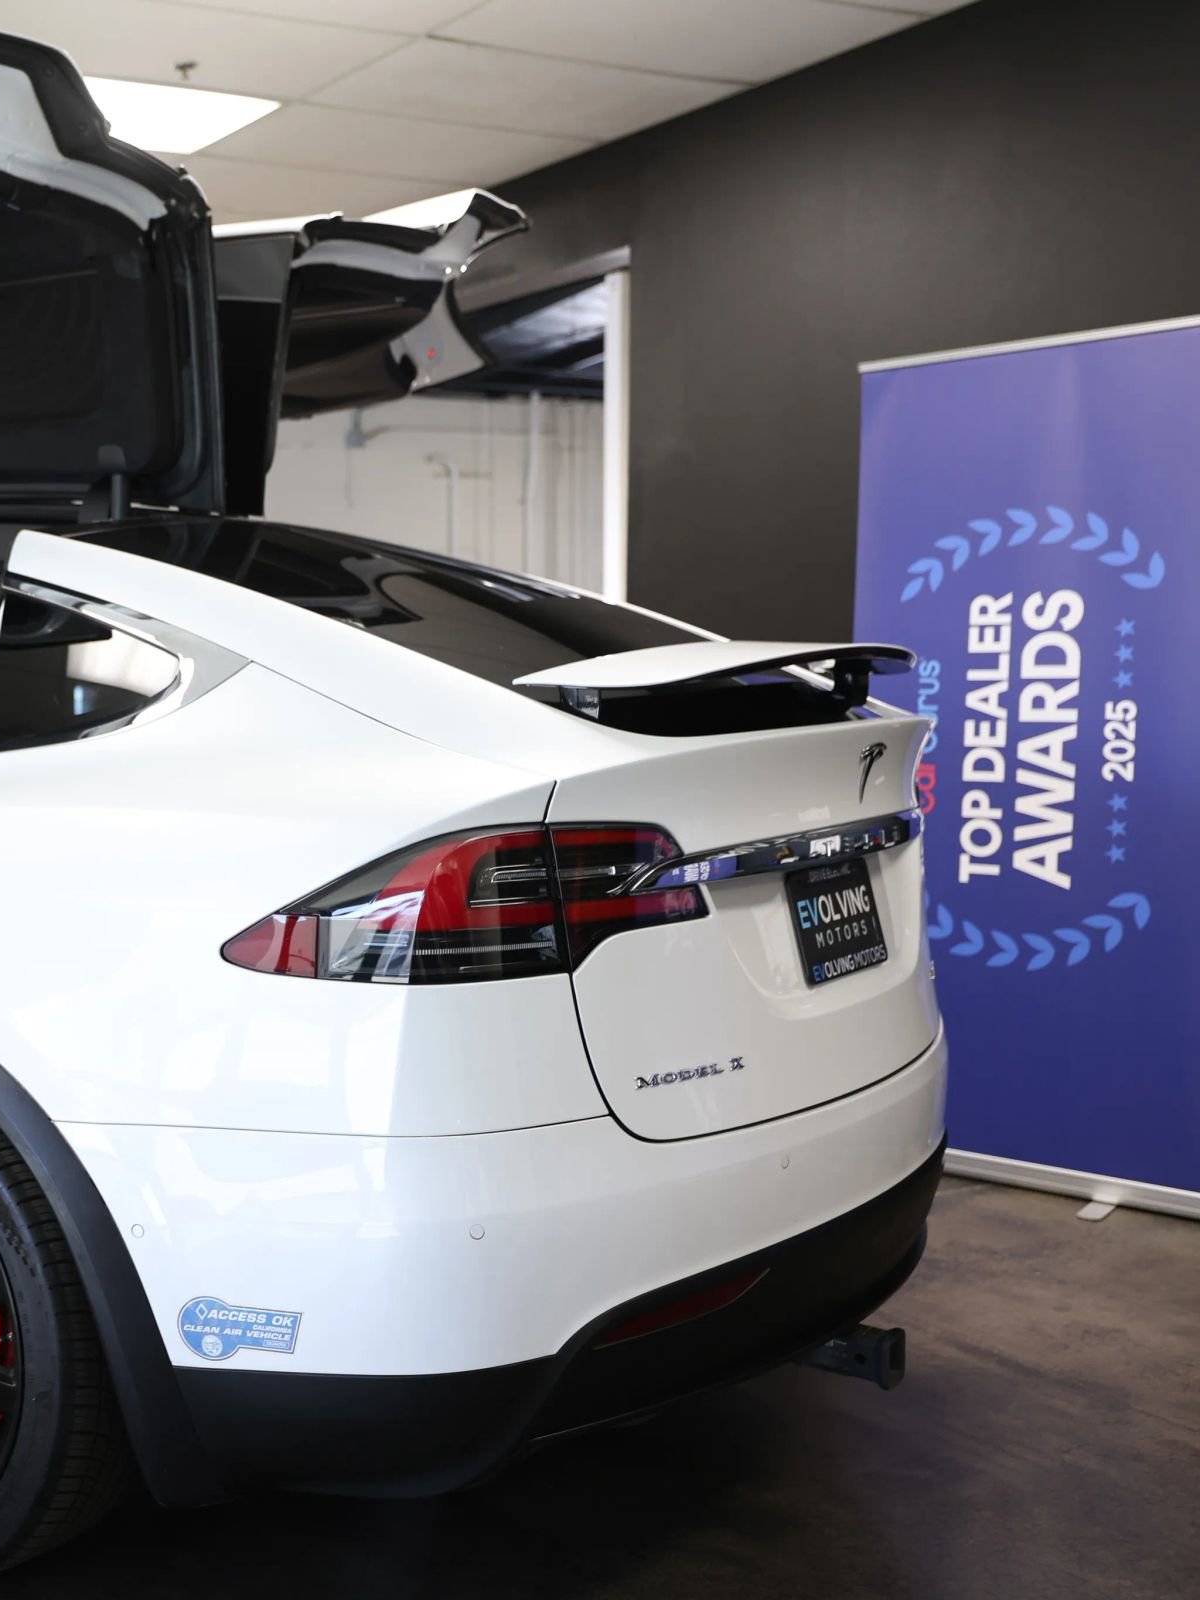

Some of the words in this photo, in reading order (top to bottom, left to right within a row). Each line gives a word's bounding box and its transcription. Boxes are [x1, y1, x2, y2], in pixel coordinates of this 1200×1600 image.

[962, 591, 1014, 783] DEALER
[1012, 588, 1086, 891] AWARDS
[1101, 699, 1138, 783] 2025
[959, 789, 1004, 884] TOP
[798, 886, 870, 929] EVOLVING
[816, 920, 868, 948] MOTORS
[635, 1063, 725, 1090] MODEL
[728, 1056, 745, 1072] X
[183, 1324, 220, 1334] CLEAN
[222, 1328, 242, 1336] AIR
[246, 1330, 292, 1341] VEHICLE
[207, 1309, 267, 1324] ACCESS
[272, 1316, 294, 1326] OK
